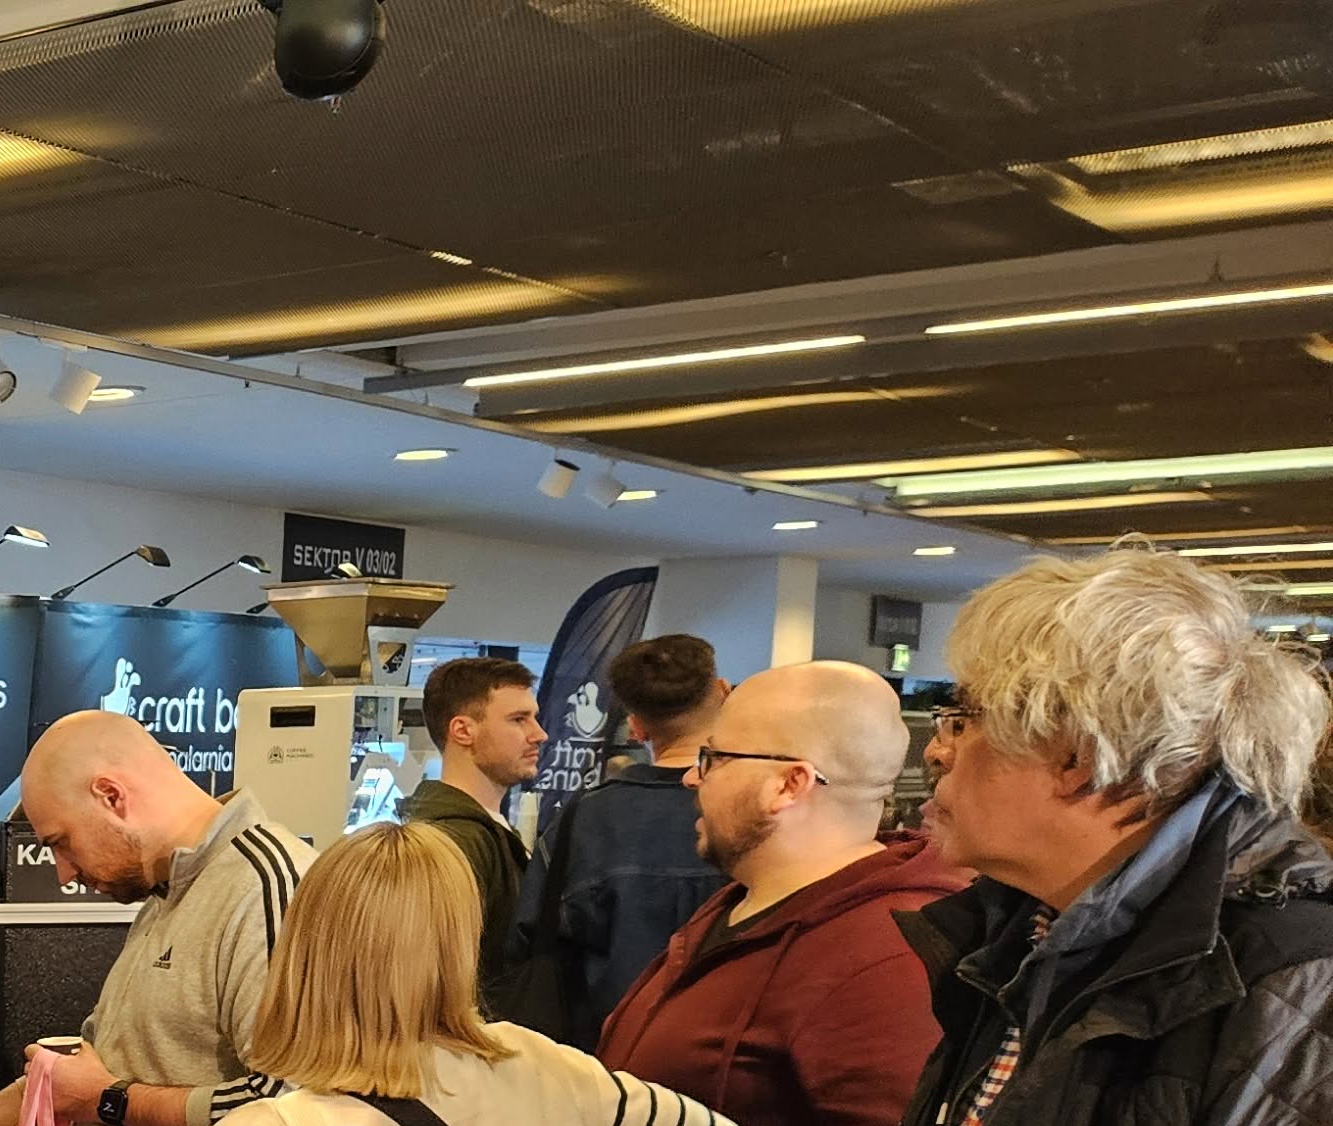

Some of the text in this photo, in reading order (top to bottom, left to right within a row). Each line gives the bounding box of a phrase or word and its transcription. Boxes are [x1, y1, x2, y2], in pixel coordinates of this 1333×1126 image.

[293, 544, 397, 576] SEKTOR V 03/02
[137, 686, 206, 733] craft
